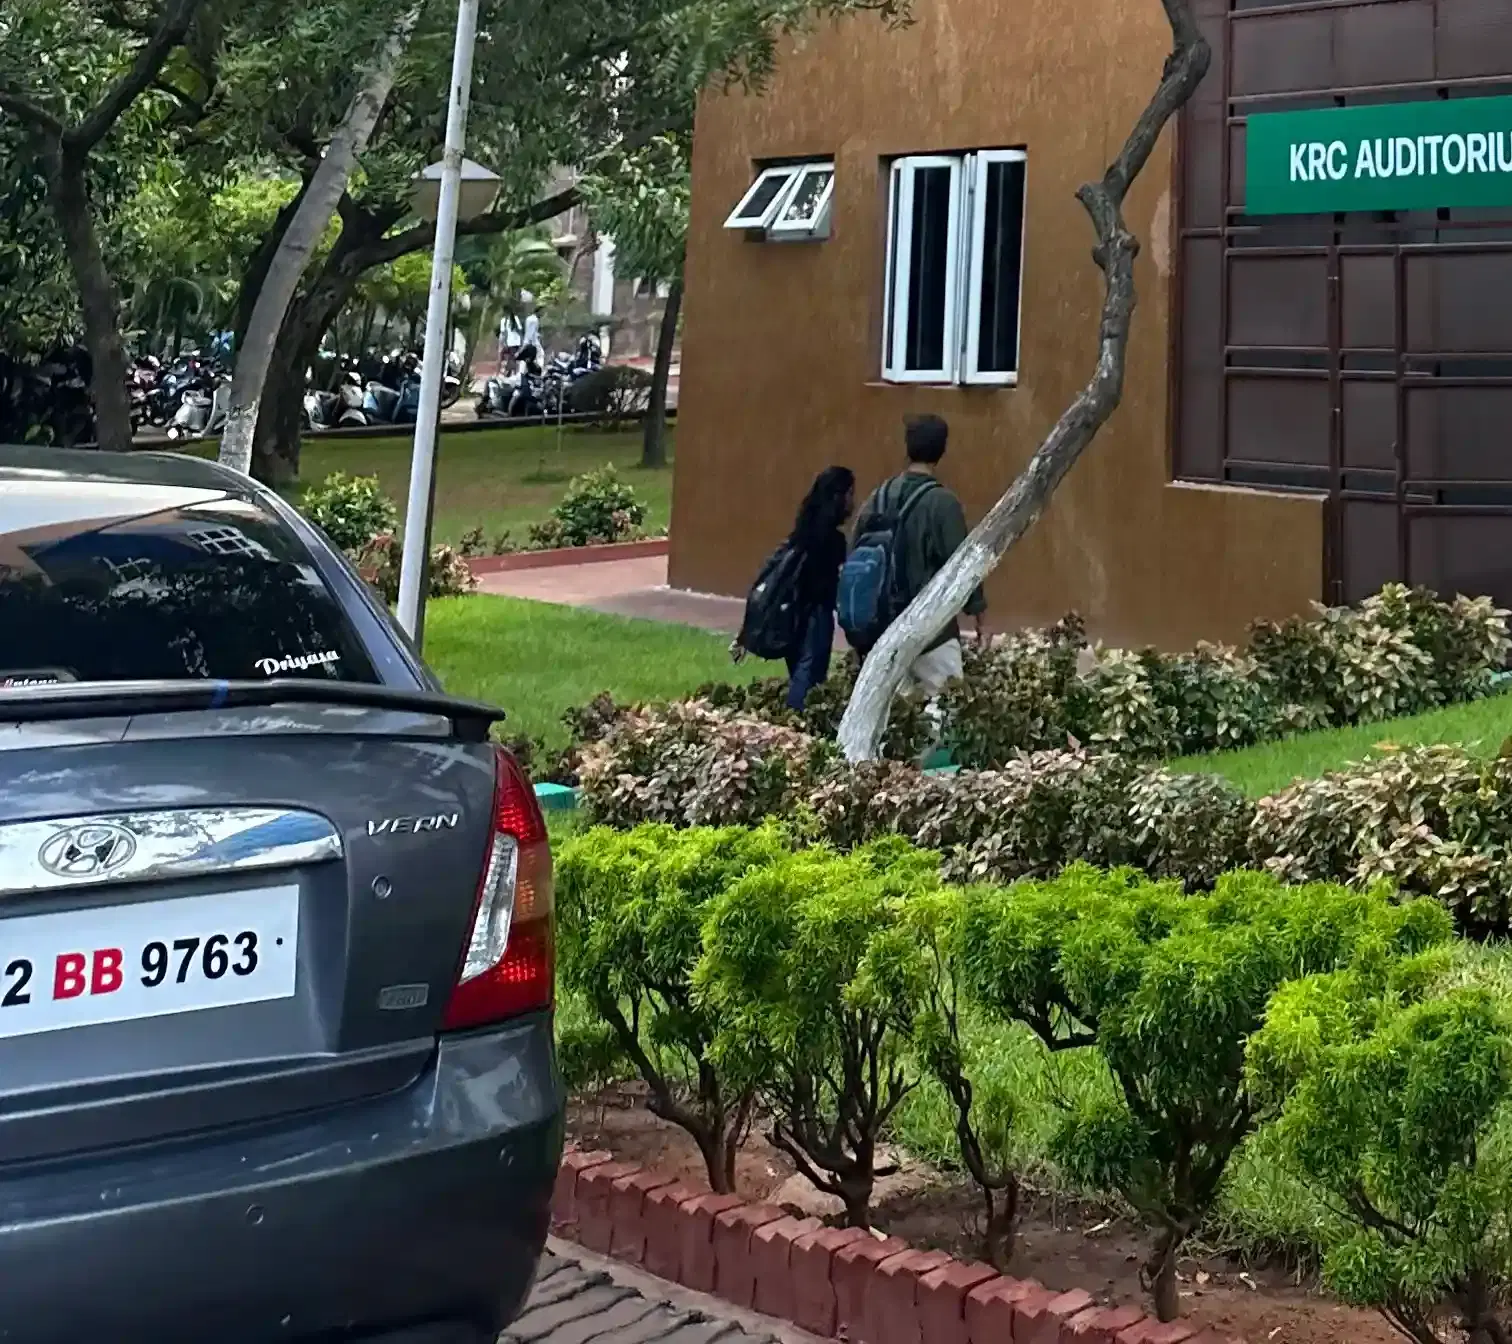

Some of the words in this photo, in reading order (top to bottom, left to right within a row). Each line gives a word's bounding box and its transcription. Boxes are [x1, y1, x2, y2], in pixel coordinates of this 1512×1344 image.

[1289, 140, 1348, 182] KRC
[52, 947, 124, 1001] BB
[140, 930, 259, 988] 9763
